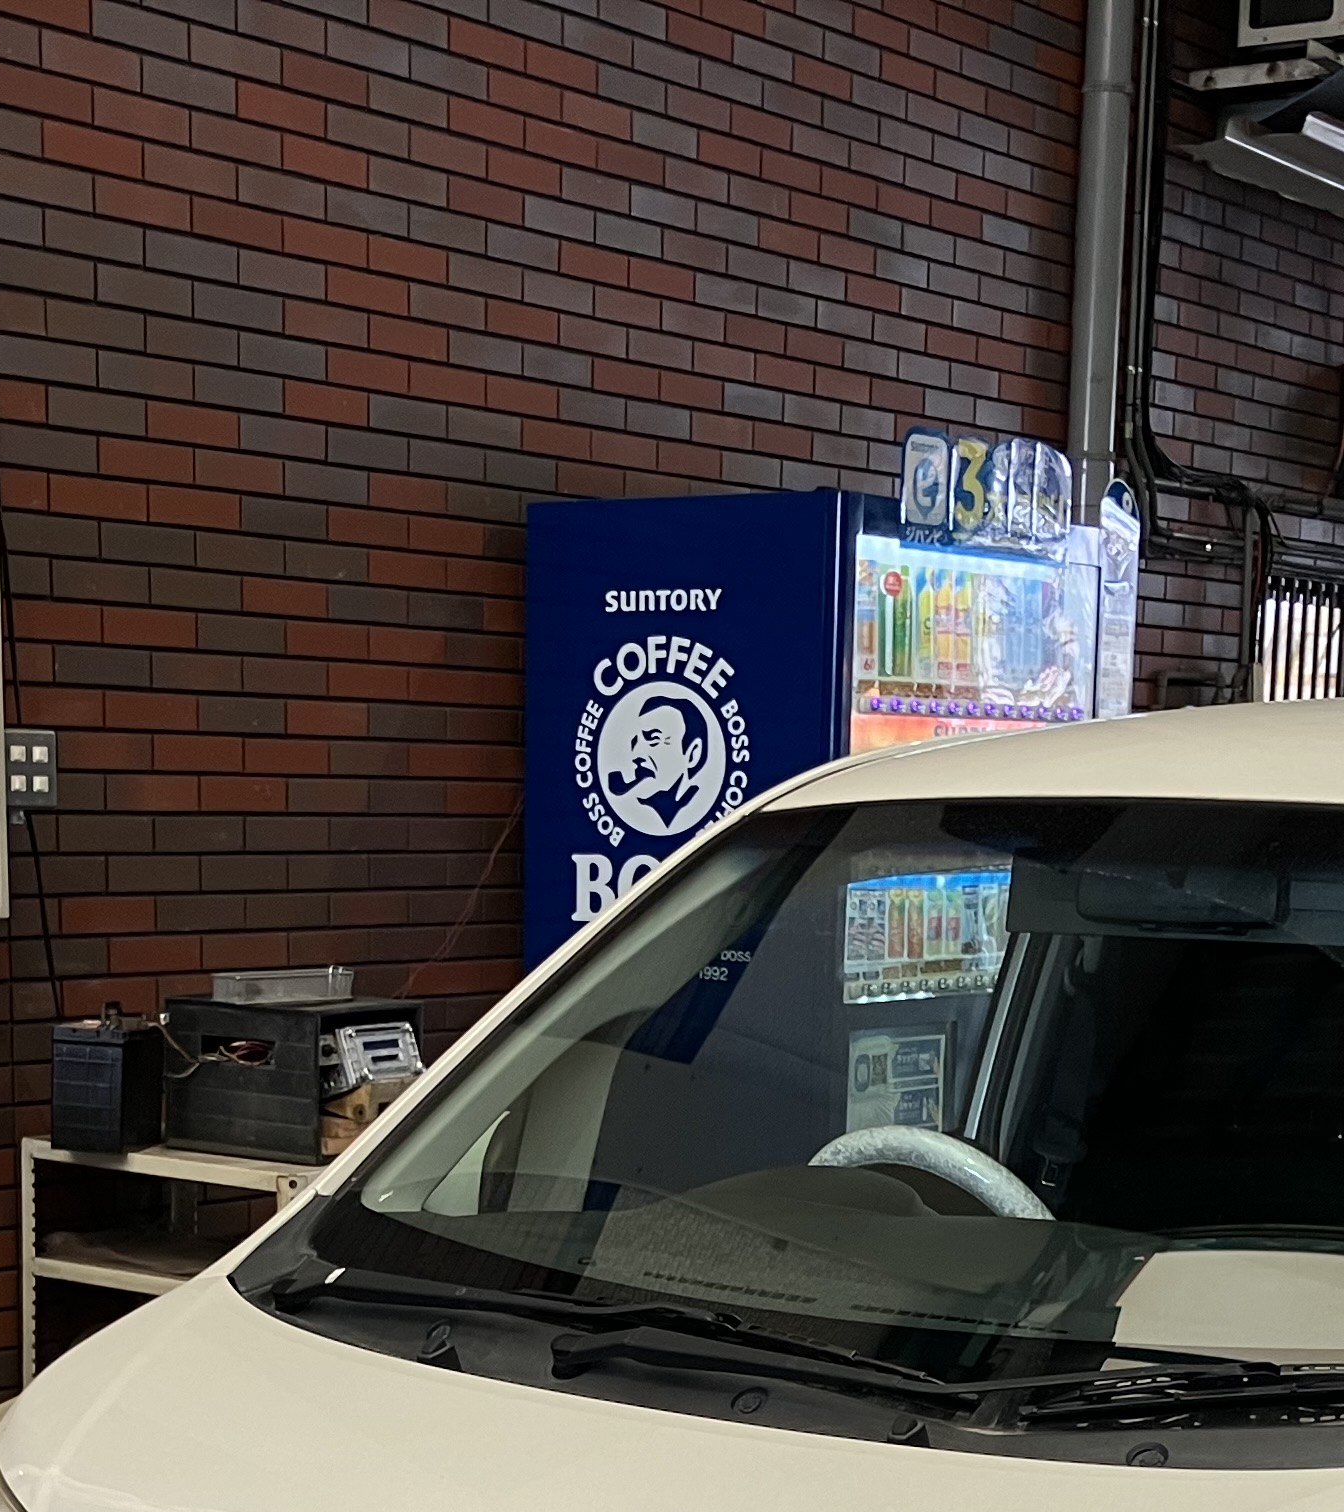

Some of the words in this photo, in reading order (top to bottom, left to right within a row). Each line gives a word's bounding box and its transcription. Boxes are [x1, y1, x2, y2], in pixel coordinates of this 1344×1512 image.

[604, 588, 723, 613] SUNTORY
[593, 635, 735, 700] COFFEE
[574, 699, 604, 788] COFFEE
[720, 699, 750, 763] BOSS
[582, 792, 625, 847] BOSS
